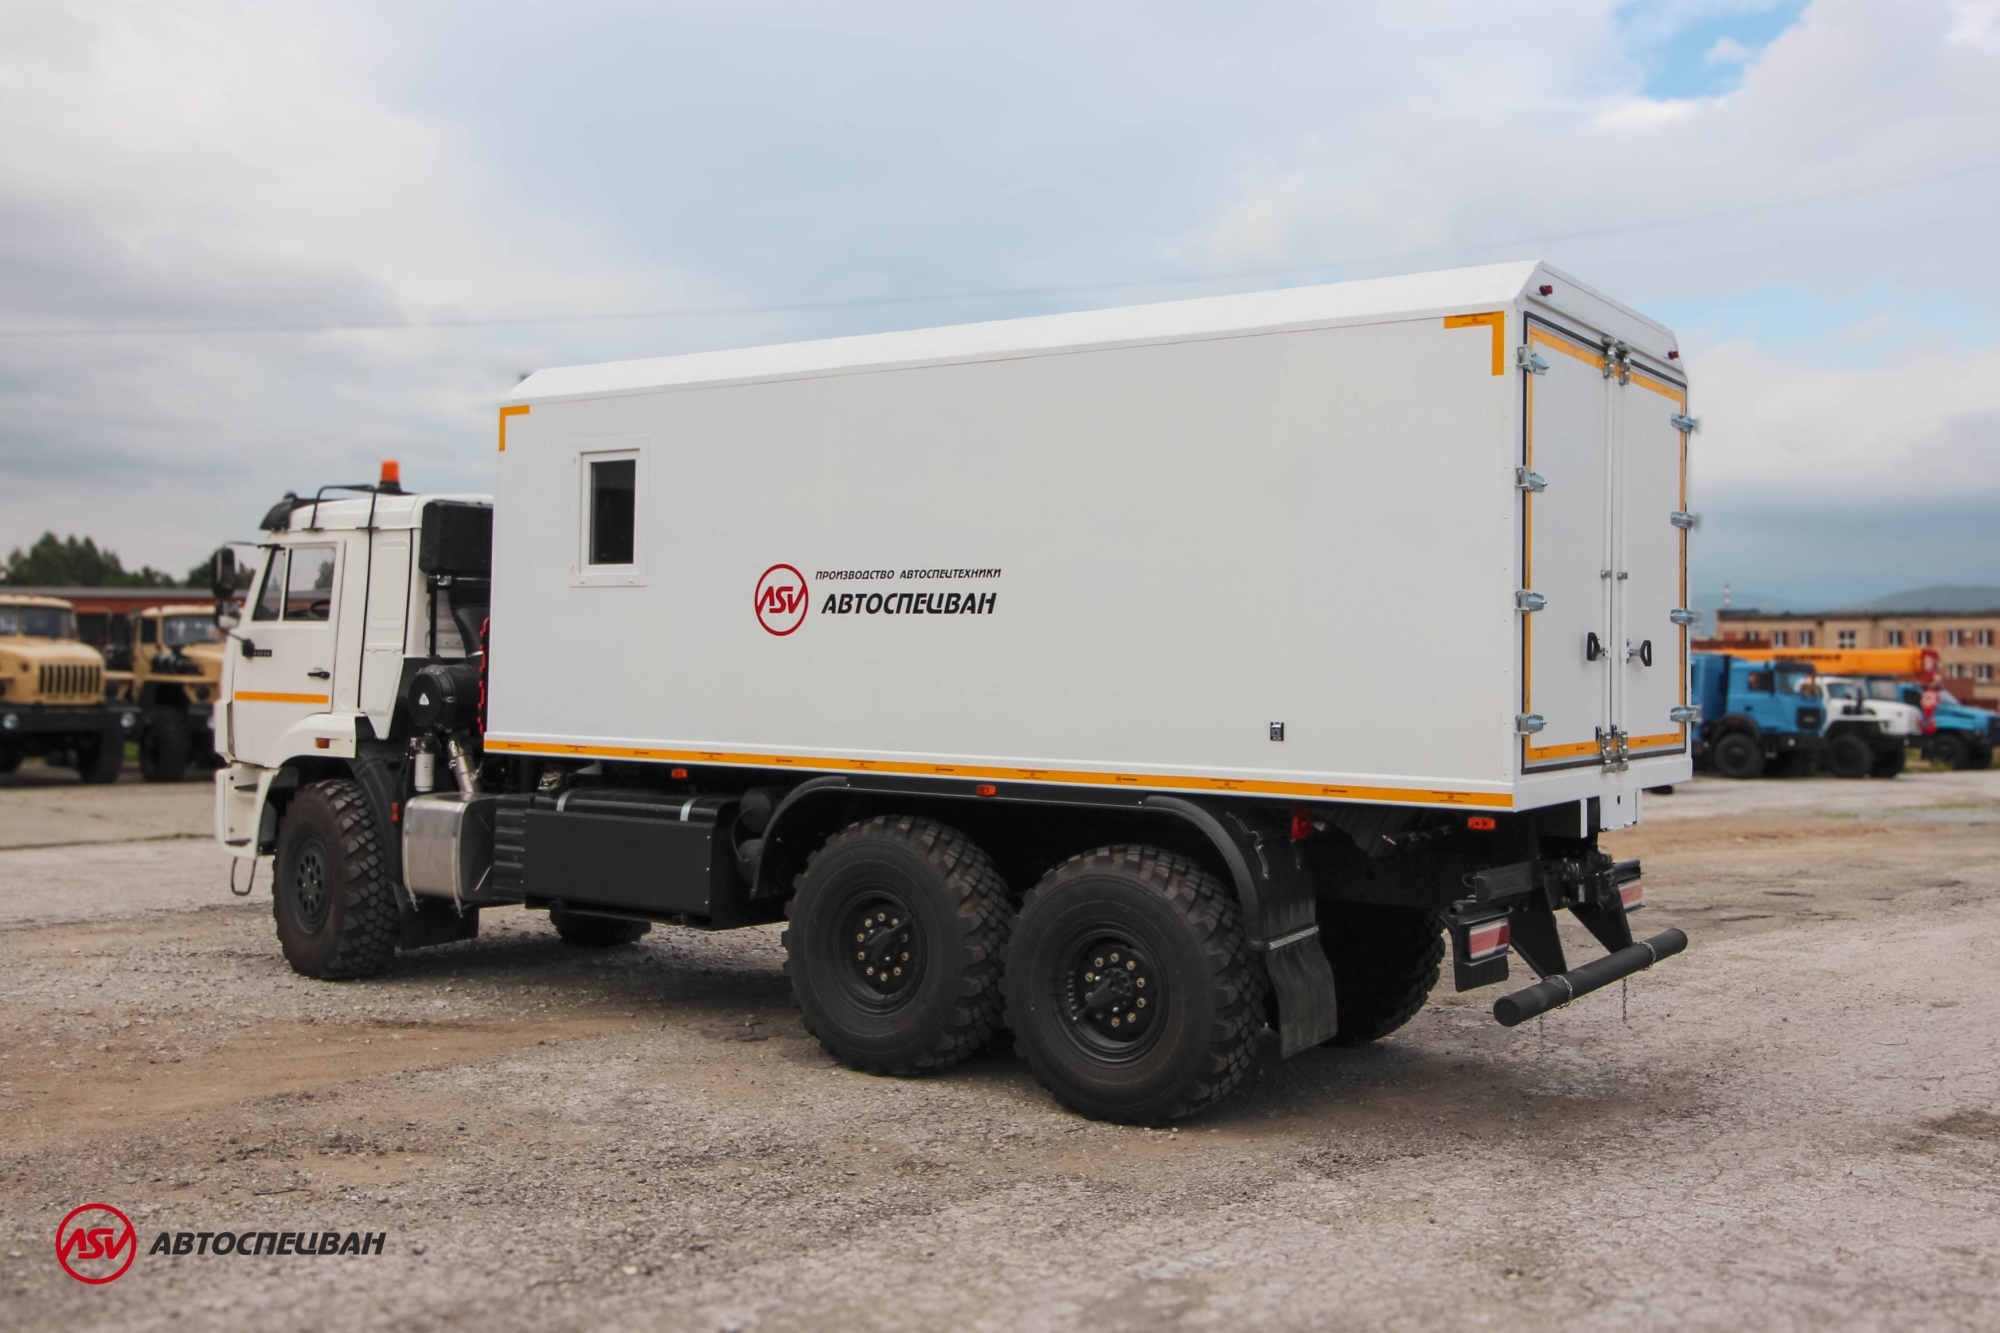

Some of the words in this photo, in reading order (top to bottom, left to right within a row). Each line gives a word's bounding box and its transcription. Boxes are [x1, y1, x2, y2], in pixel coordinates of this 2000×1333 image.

[815, 570, 895, 580] ПРОИЗВОДСТВО
[899, 568, 1002, 579] АВТОСПЕЦТЕХНИКИ
[821, 592, 997, 614] АВТОСПЕЦВАН
